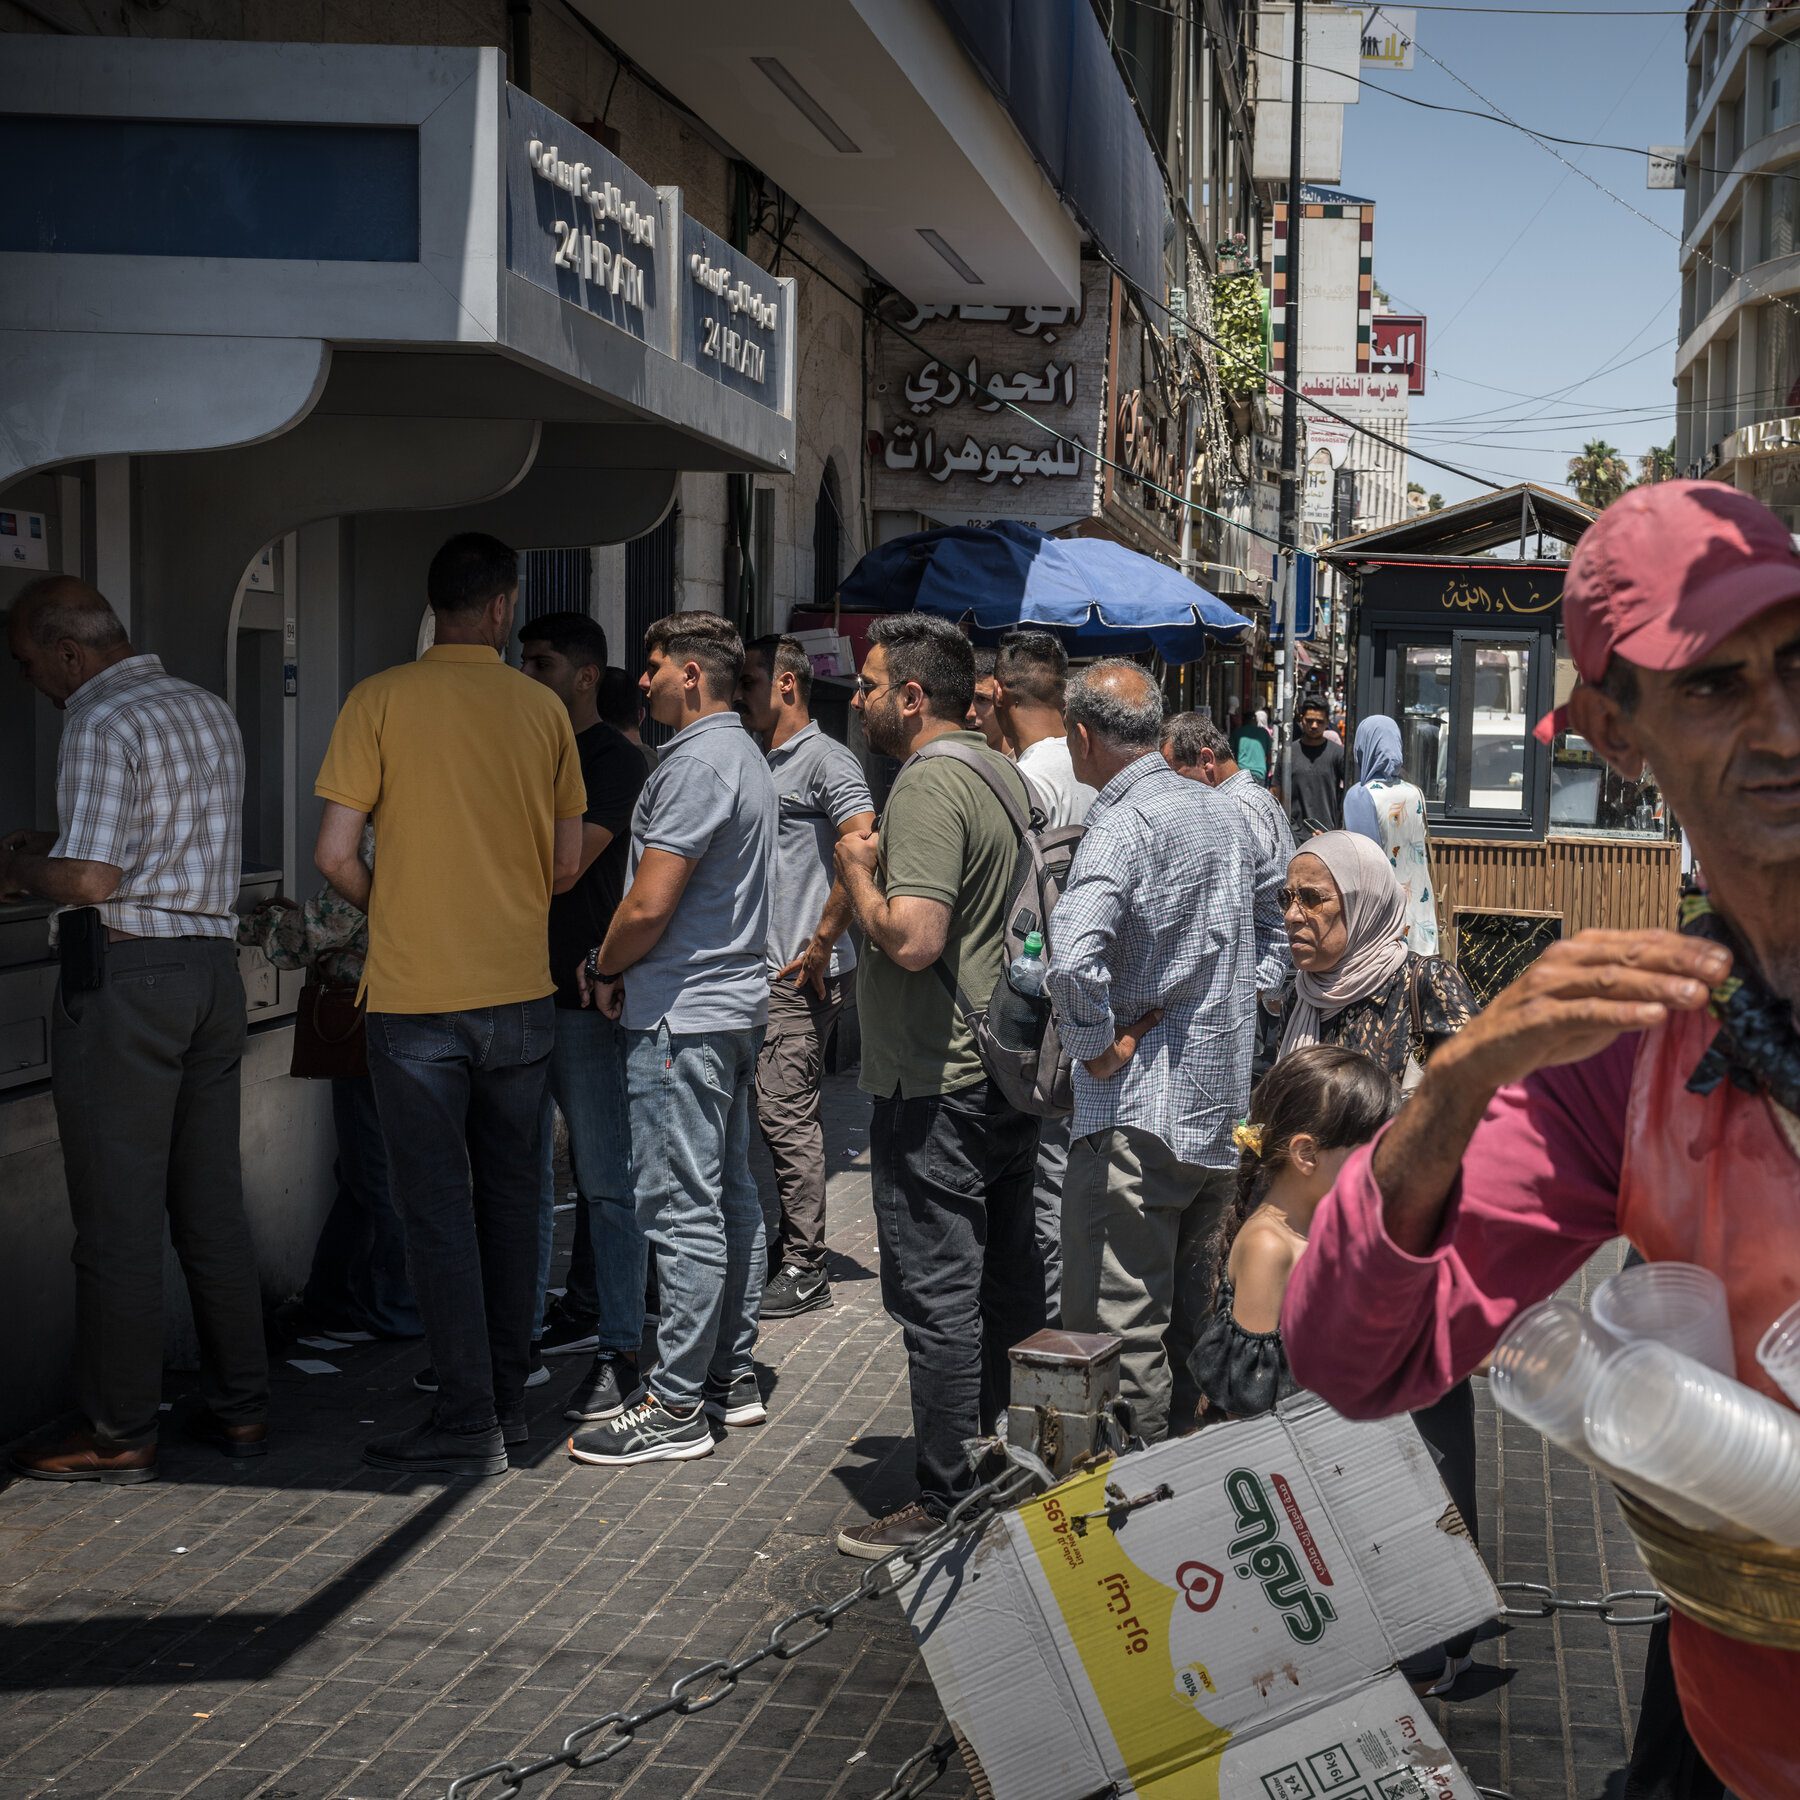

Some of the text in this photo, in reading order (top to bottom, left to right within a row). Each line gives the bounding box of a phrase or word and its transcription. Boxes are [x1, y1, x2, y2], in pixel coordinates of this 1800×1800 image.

[554, 220, 644, 311] 24 HR ATM
[703, 317, 765, 384] 24 HR ATM
[905, 357, 1076, 413] الحواري
[1367, 376, 1399, 402] مدرسة
[885, 425, 1083, 485] للمجوهرات
[1043, 1499, 1068, 1534] 4.95
[1279, 1484, 1292, 1504] صحة
[1300, 1530, 1311, 1546] زيت
[1308, 1547, 1327, 1576] صافي
[1063, 1546, 1077, 1569] صافي
[1067, 1533, 1084, 1565] Liter Net
[1224, 1467, 1338, 1645] صافي
[1097, 1573, 1149, 1655] زيت ذرة
[1395, 1715, 1416, 1738] زيت
